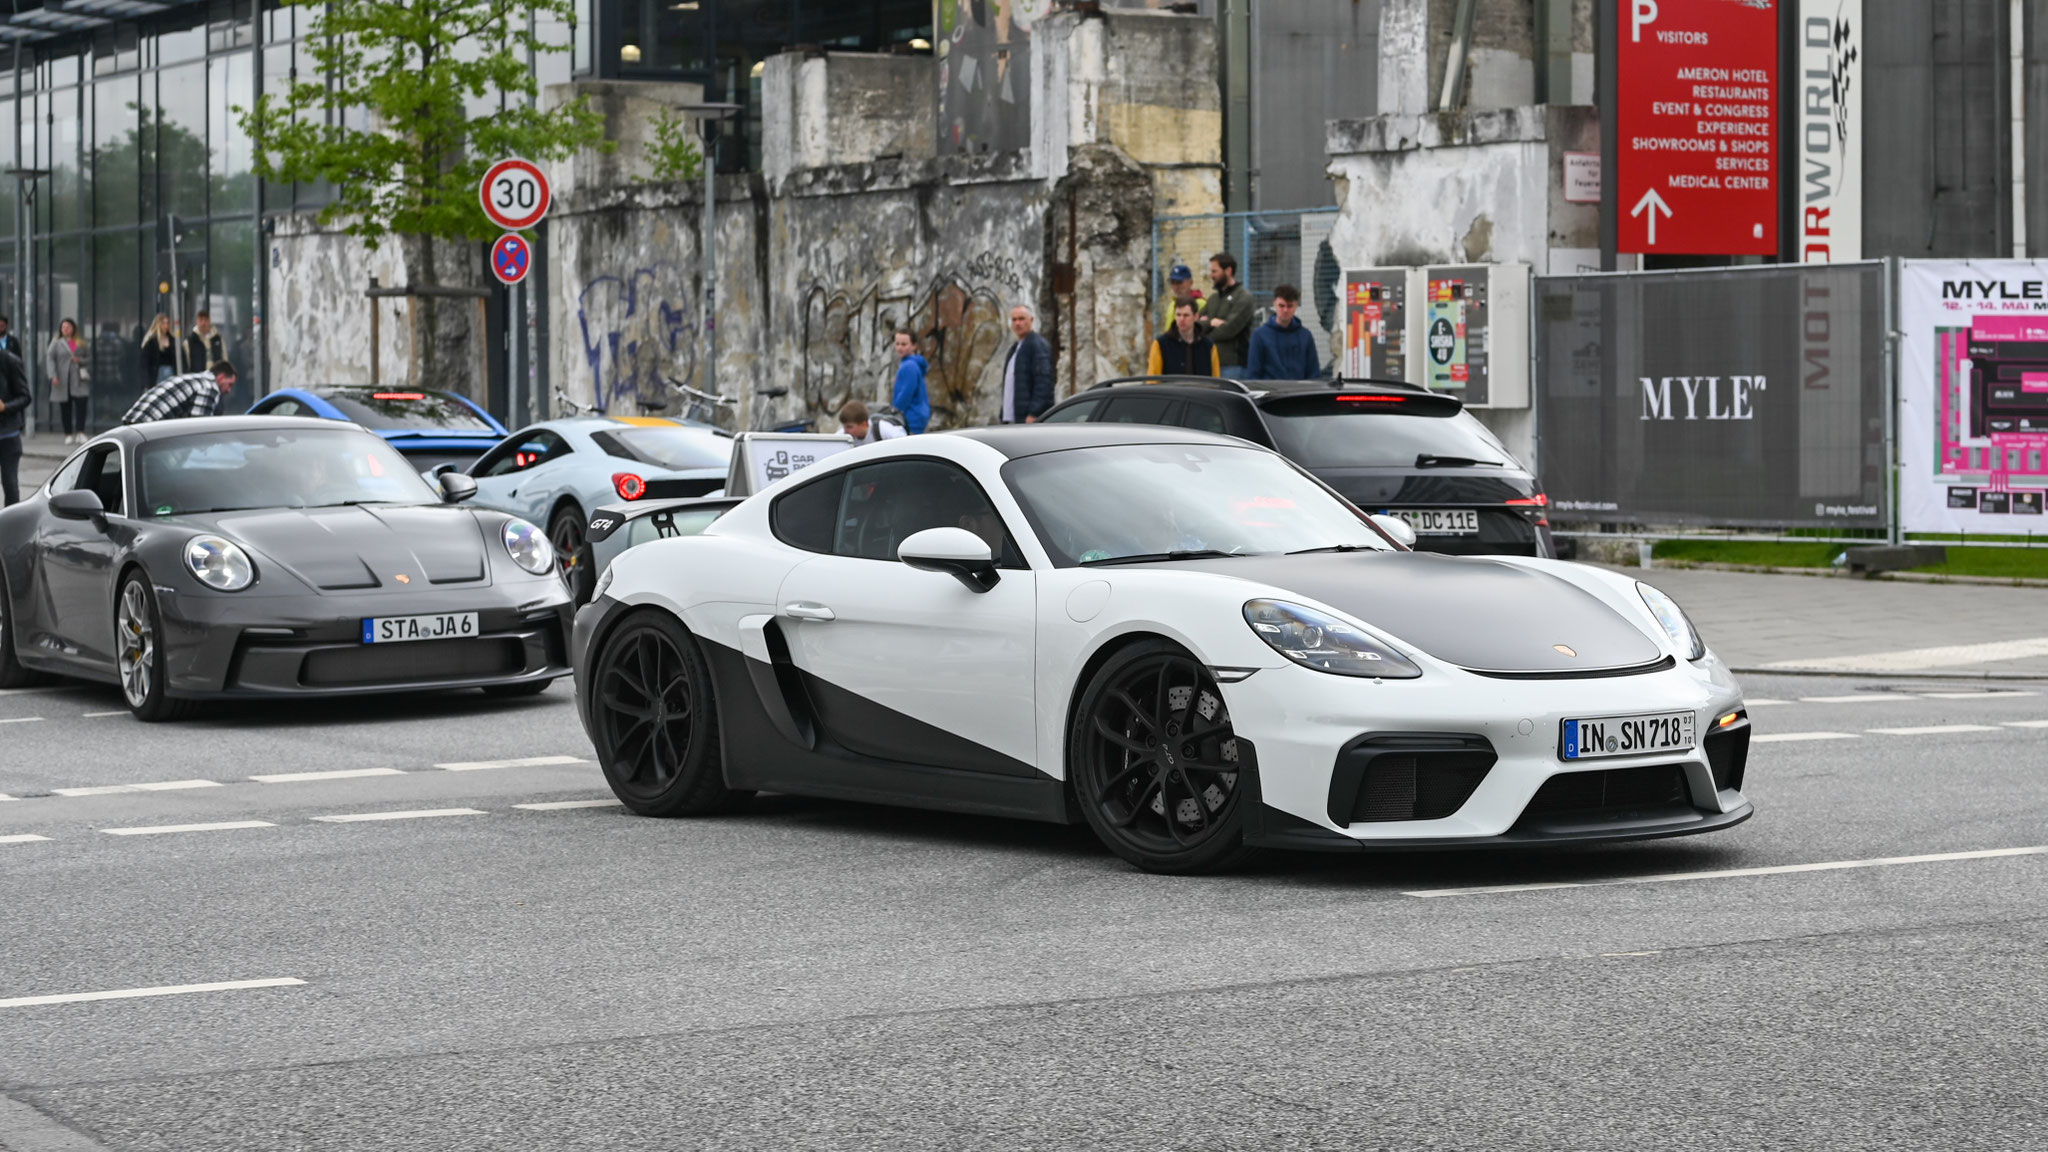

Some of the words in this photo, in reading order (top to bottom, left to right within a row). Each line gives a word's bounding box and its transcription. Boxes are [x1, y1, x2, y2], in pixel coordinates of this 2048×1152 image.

[1632, 0, 1658, 42] P
[1656, 31, 1708, 45] VISITORS
[1677, 67, 1729, 81] AMERON
[1732, 69, 1769, 83] HOTEL
[1692, 85, 1769, 100] RESTAURANTS
[1652, 102, 1690, 115] EVENT
[1693, 103, 1702, 116] &
[1705, 104, 1769, 118] CONGRESS
[1697, 121, 1769, 136] EXPERIENCE
[1632, 137, 1716, 152] SHOWROOMS
[1719, 140, 1728, 152] &
[1731, 140, 1769, 153] SHOPS
[1715, 157, 1769, 171] SERVICES
[1669, 175, 1721, 188] MEDICAL
[1725, 176, 1769, 190] CENTER
[497, 179, 534, 209] 30
[1942, 281, 2043, 299] MYLE
[2002, 302, 2029, 310] MAI
[1639, 376, 1753, 420] MYLE
[792, 455, 814, 463] CAR
[591, 518, 614, 531] GT4
[1422, 512, 1443, 529] DC
[1446, 512, 1477, 529] 11E
[382, 619, 419, 639] STA
[433, 616, 456, 636] JA
[461, 615, 472, 634] 6
[1580, 723, 1604, 753] IN
[1621, 720, 1645, 750] SN
[1650, 717, 1681, 747] 718
